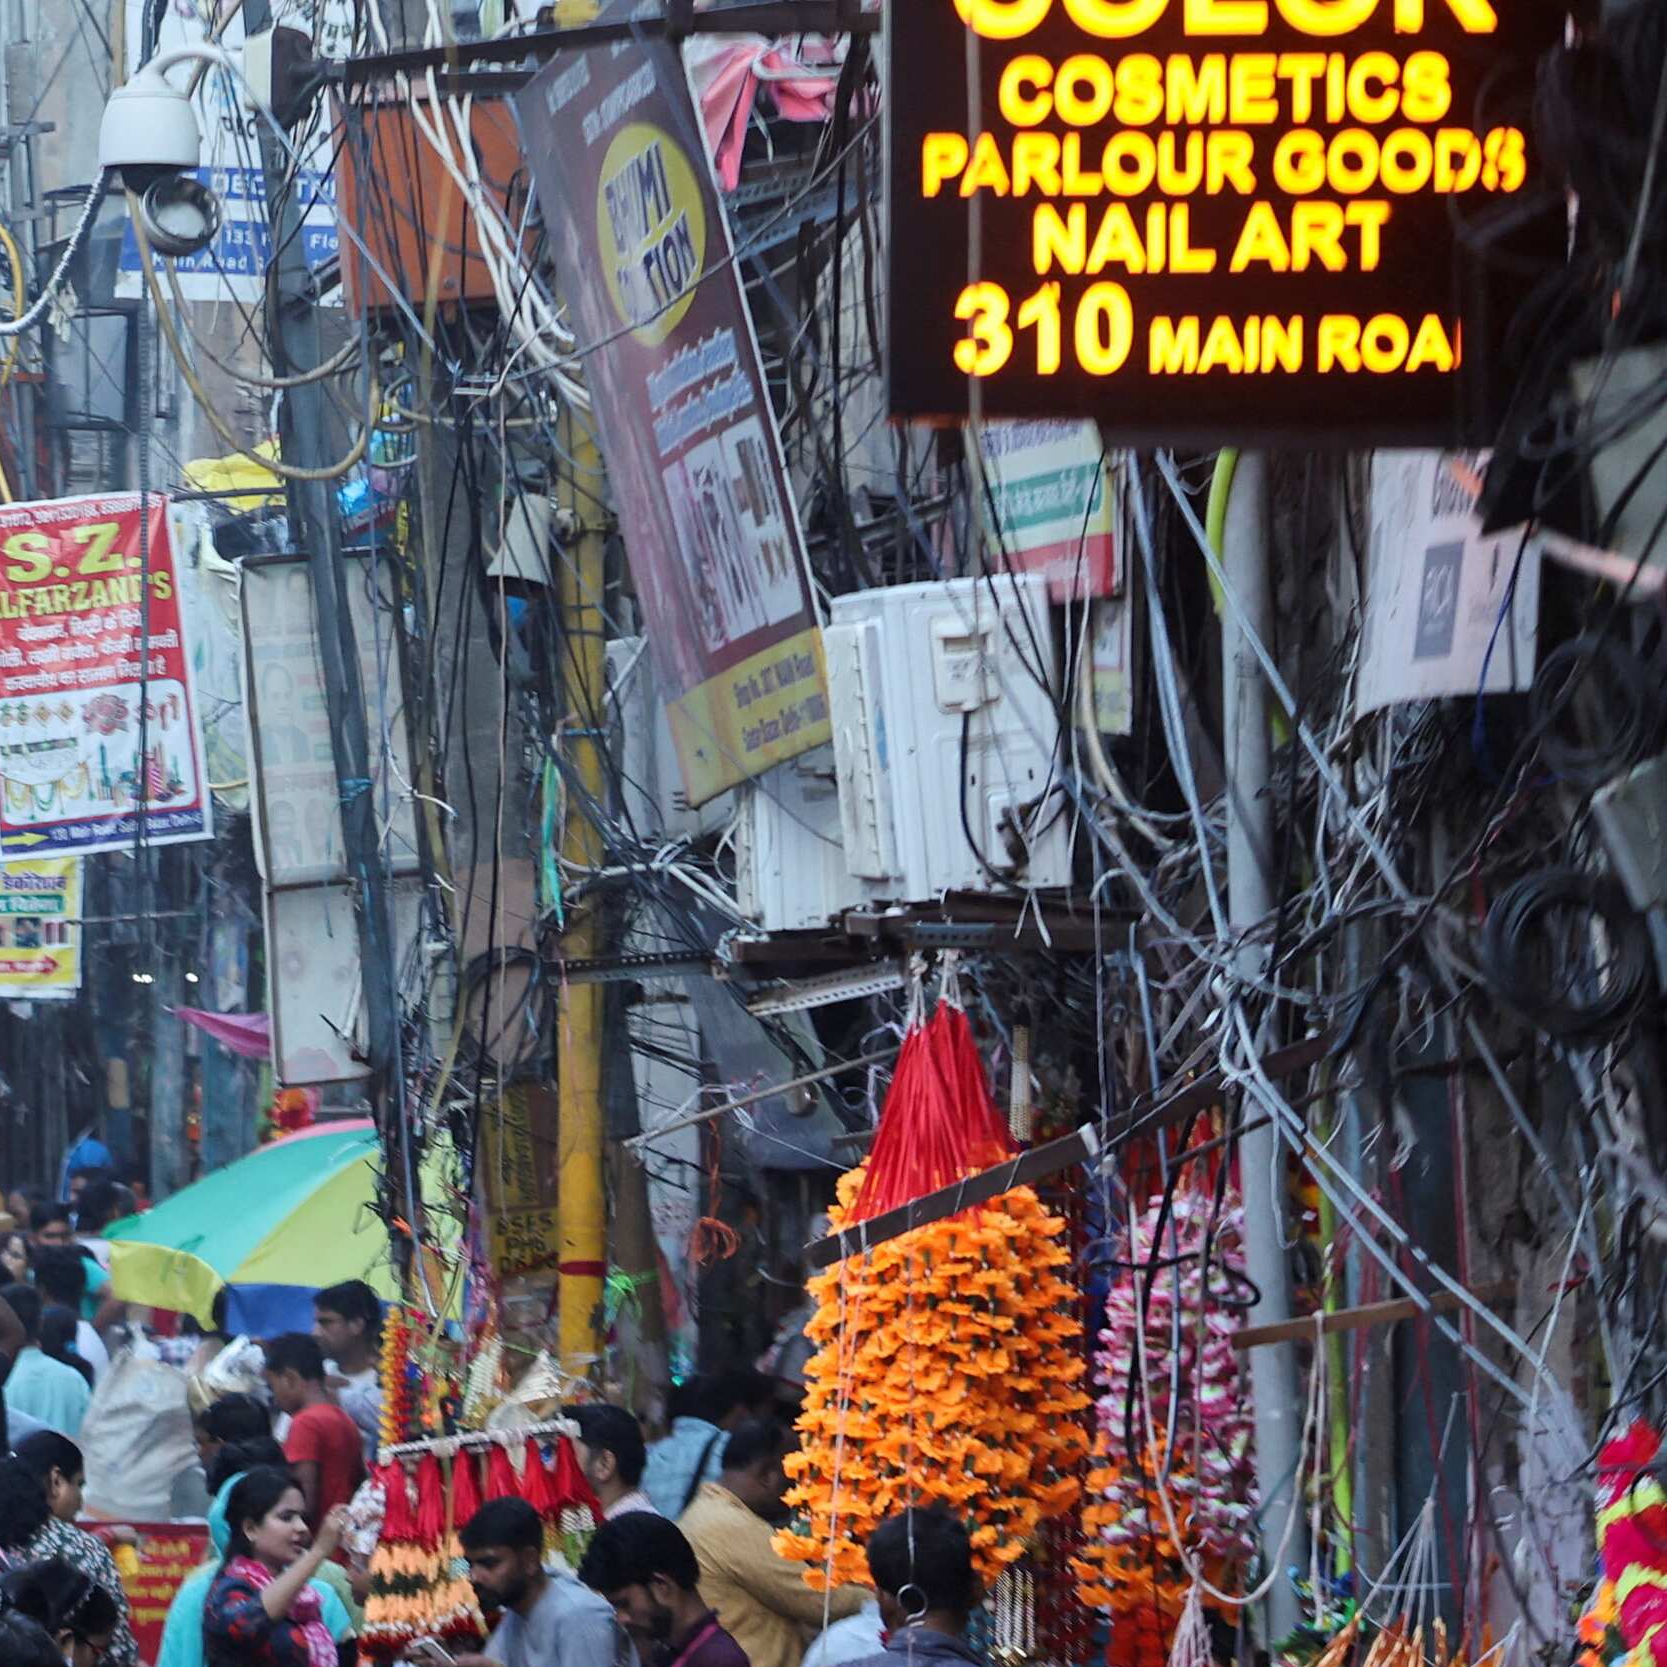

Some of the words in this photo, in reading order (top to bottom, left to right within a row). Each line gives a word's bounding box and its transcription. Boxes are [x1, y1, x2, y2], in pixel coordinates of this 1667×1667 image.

[998, 51, 1452, 127] COSMETICS
[921, 130, 1256, 197] PARLOUR
[1272, 127, 1526, 194] GOODS
[1032, 201, 1216, 275] NAIL
[1229, 200, 1392, 273] ART
[953, 281, 1134, 376] 310
[1149, 315, 1303, 374] MAIN
[1317, 313, 1462, 373] ROA
[1, 522, 143, 584] S.Z.
